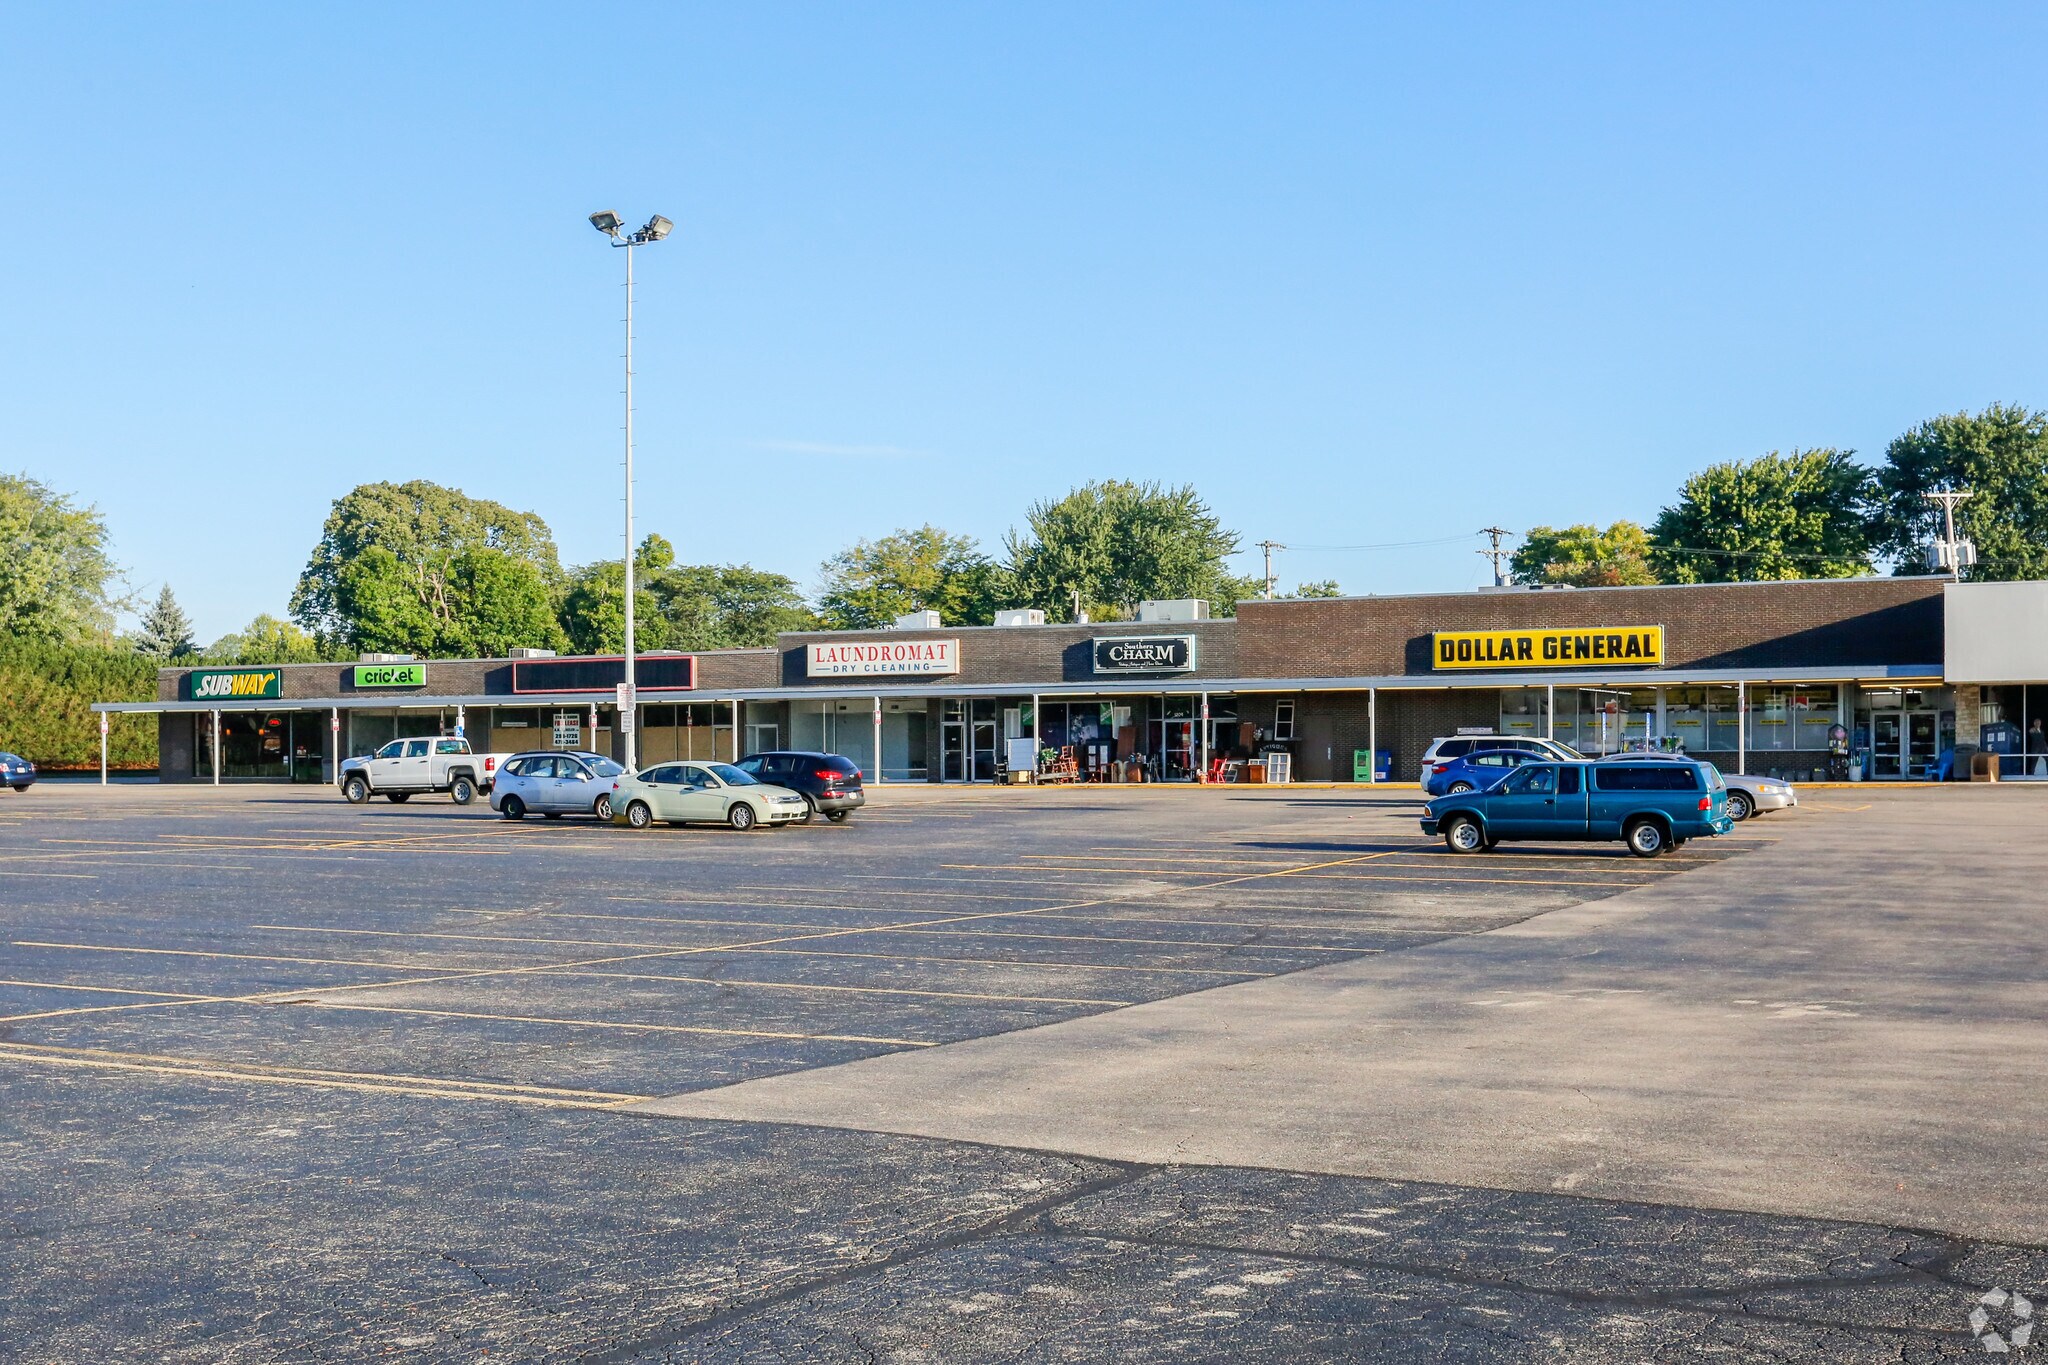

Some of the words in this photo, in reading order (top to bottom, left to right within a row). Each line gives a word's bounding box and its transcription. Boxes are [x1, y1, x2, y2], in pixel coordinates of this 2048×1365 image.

[815, 644, 948, 663] LAUNDROMAT
[1108, 645, 1175, 664] CHARM
[1124, 642, 1154, 650] Southern
[1439, 637, 1534, 662] DOLLAR
[1542, 634, 1656, 660] GENERAL
[364, 668, 414, 684] cricket
[833, 664, 856, 673] DRY
[864, 663, 930, 672] CLEANING
[195, 672, 275, 698] SUBWAY
